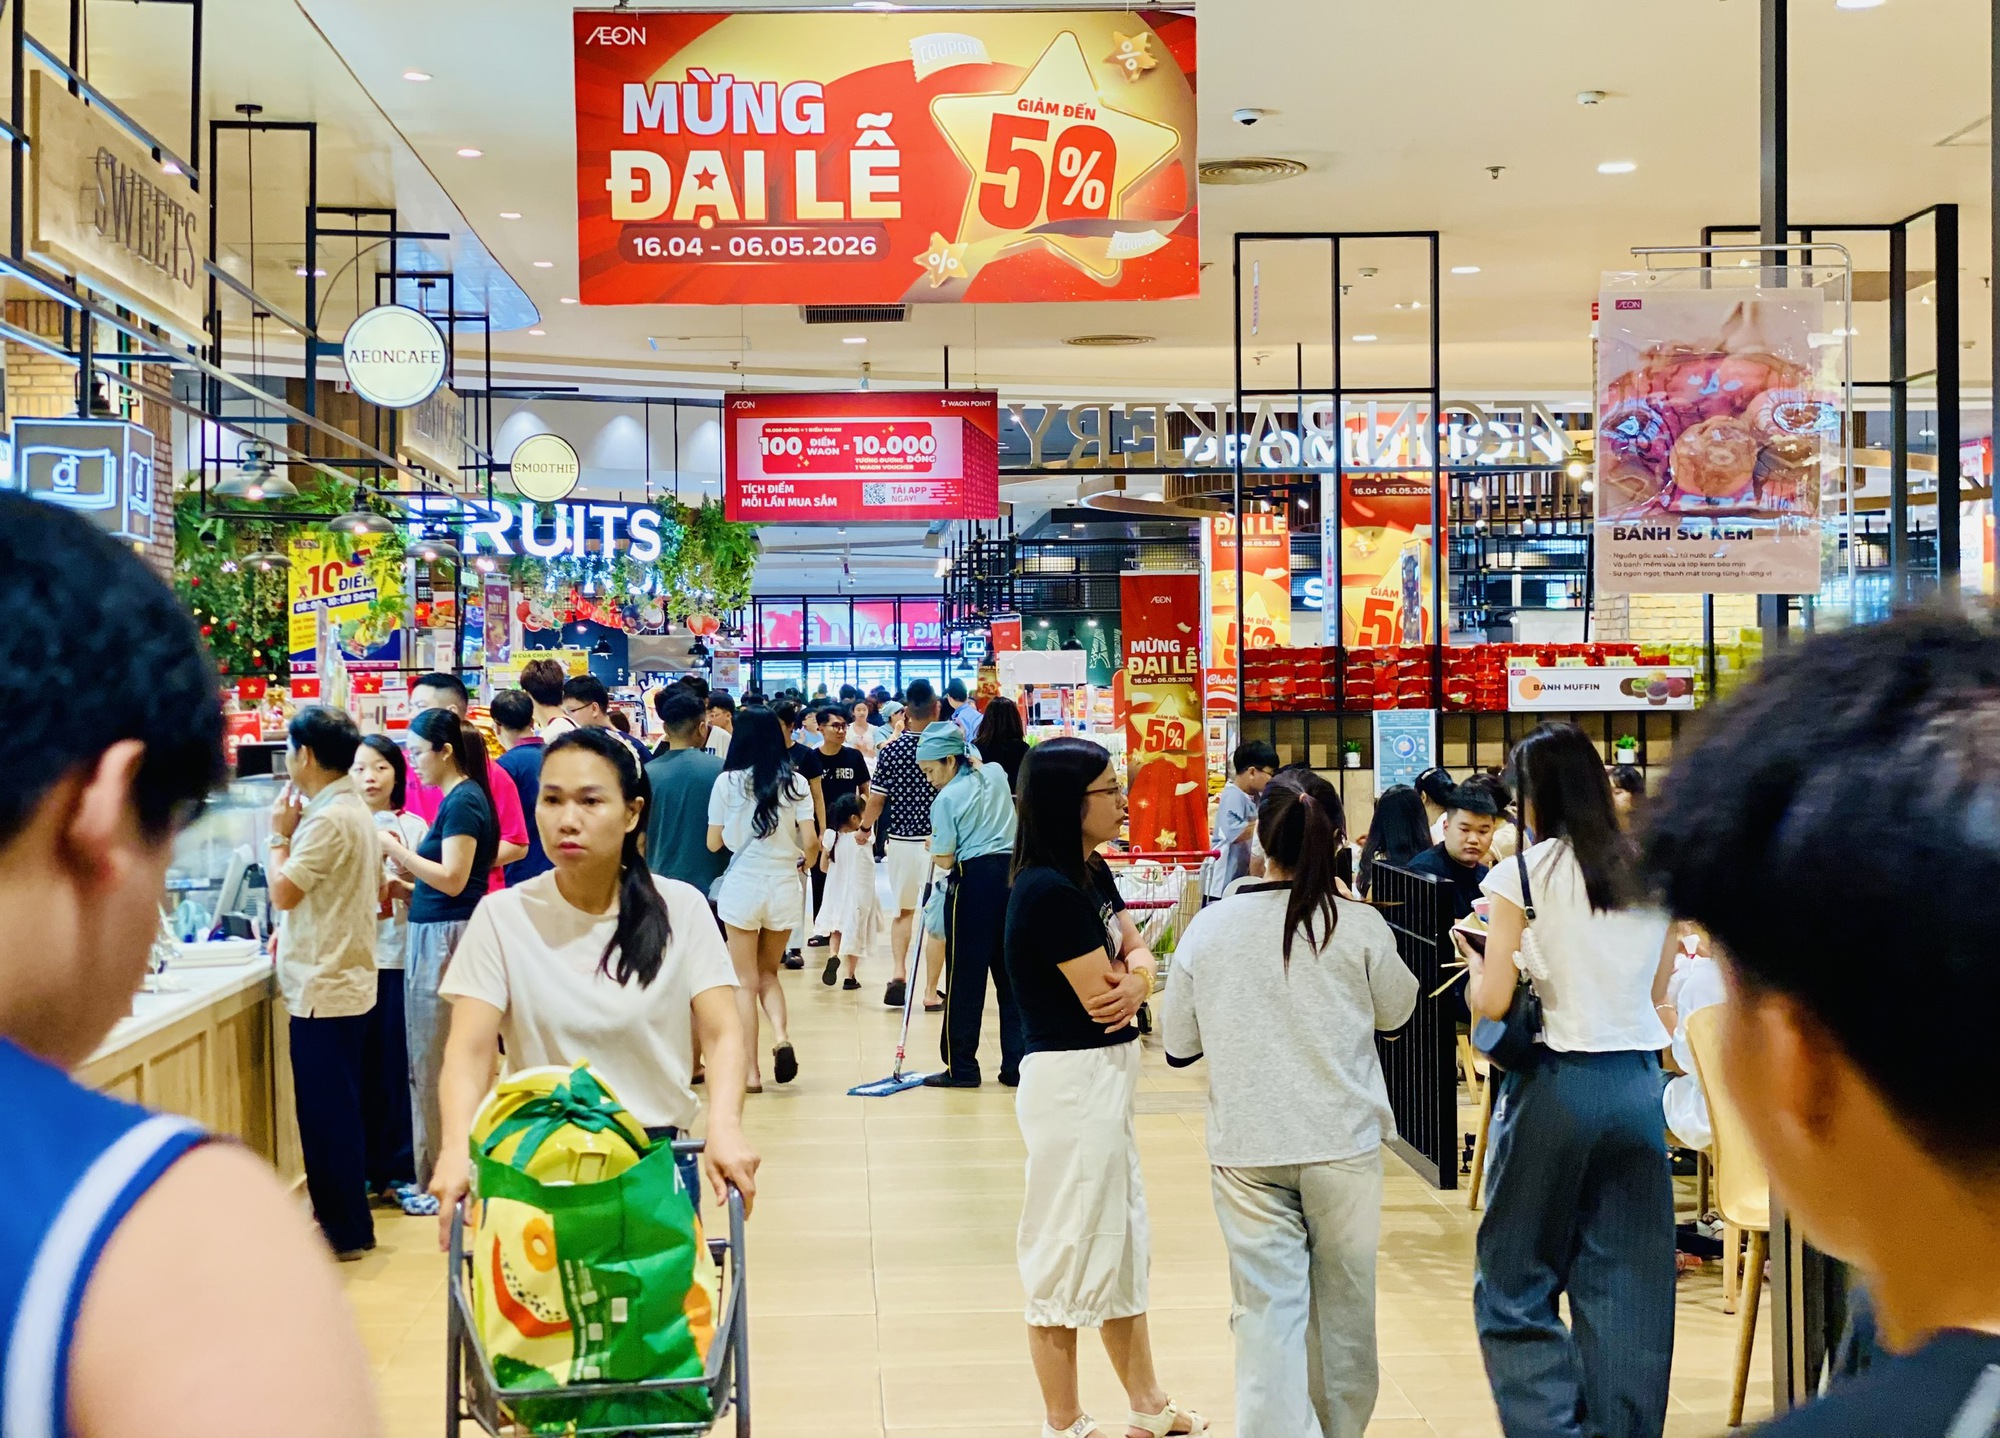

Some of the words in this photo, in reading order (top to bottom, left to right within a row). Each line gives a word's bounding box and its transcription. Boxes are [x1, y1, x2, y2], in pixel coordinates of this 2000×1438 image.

[622, 68, 825, 135] MỪNG
[1017, 97, 1060, 117] GIẢM
[1063, 102, 1096, 121] ĐẾN
[605, 149, 766, 230] ĐẠI
[795, 112, 902, 220] LỄ
[978, 113, 1117, 233] 50%
[95, 146, 197, 290] SWEETS
[633, 237, 704, 257] 16.04
[728, 236, 877, 256] 06.05.2026
[971, 399, 992, 407] POINT
[759, 436, 803, 456] 100
[810, 435, 837, 447] ĐIỂM
[853, 435, 937, 456] 10.000
[807, 447, 840, 456] WAON
[906, 453, 937, 464] ĐỒNG
[514, 463, 576, 473] SMOOTHIE
[741, 482, 766, 494] TÍCH
[767, 481, 795, 494] ĐIỂM
[908, 486, 927, 494] APP
[1353, 487, 1378, 496] 16.04
[741, 494, 763, 507] MỖI
[787, 497, 812, 507] MUA
[1613, 524, 1671, 541] BÁNH
[1711, 527, 1753, 541] KEM
[1370, 585, 1400, 600] GIẢM
[1130, 636, 1181, 654] MỪNG
[1127, 656, 1167, 677] ĐẠI
[1172, 646, 1198, 674] LỄ
[1533, 681, 1561, 691] BÁNH
[1563, 683, 1600, 691] MUFFIN
[1144, 718, 1186, 752] 50%
[835, 767, 855, 780] #RED
